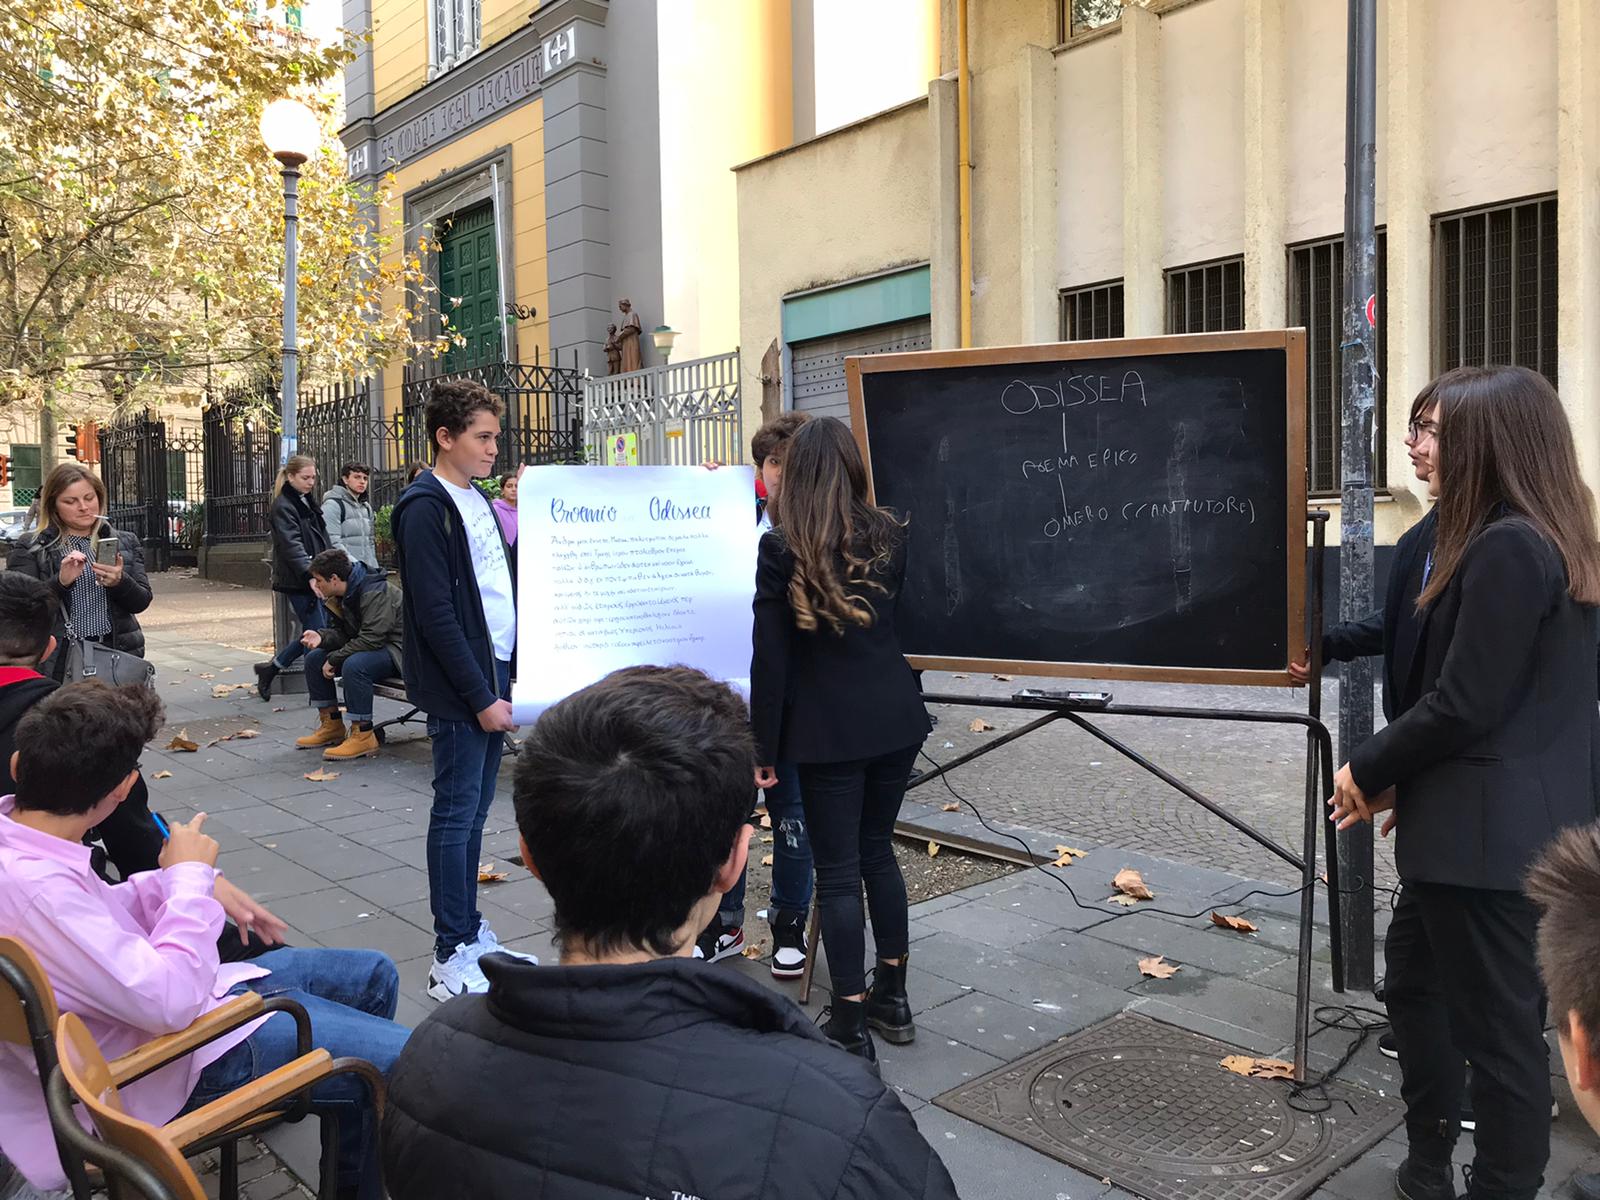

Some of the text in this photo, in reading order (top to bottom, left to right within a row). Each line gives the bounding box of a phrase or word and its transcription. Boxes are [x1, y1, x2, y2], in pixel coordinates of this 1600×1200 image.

[1001, 370, 1147, 415] ODISSEA
[550, 496, 712, 524] Proemio Odissea
[1043, 504, 1109, 538] OMERO
